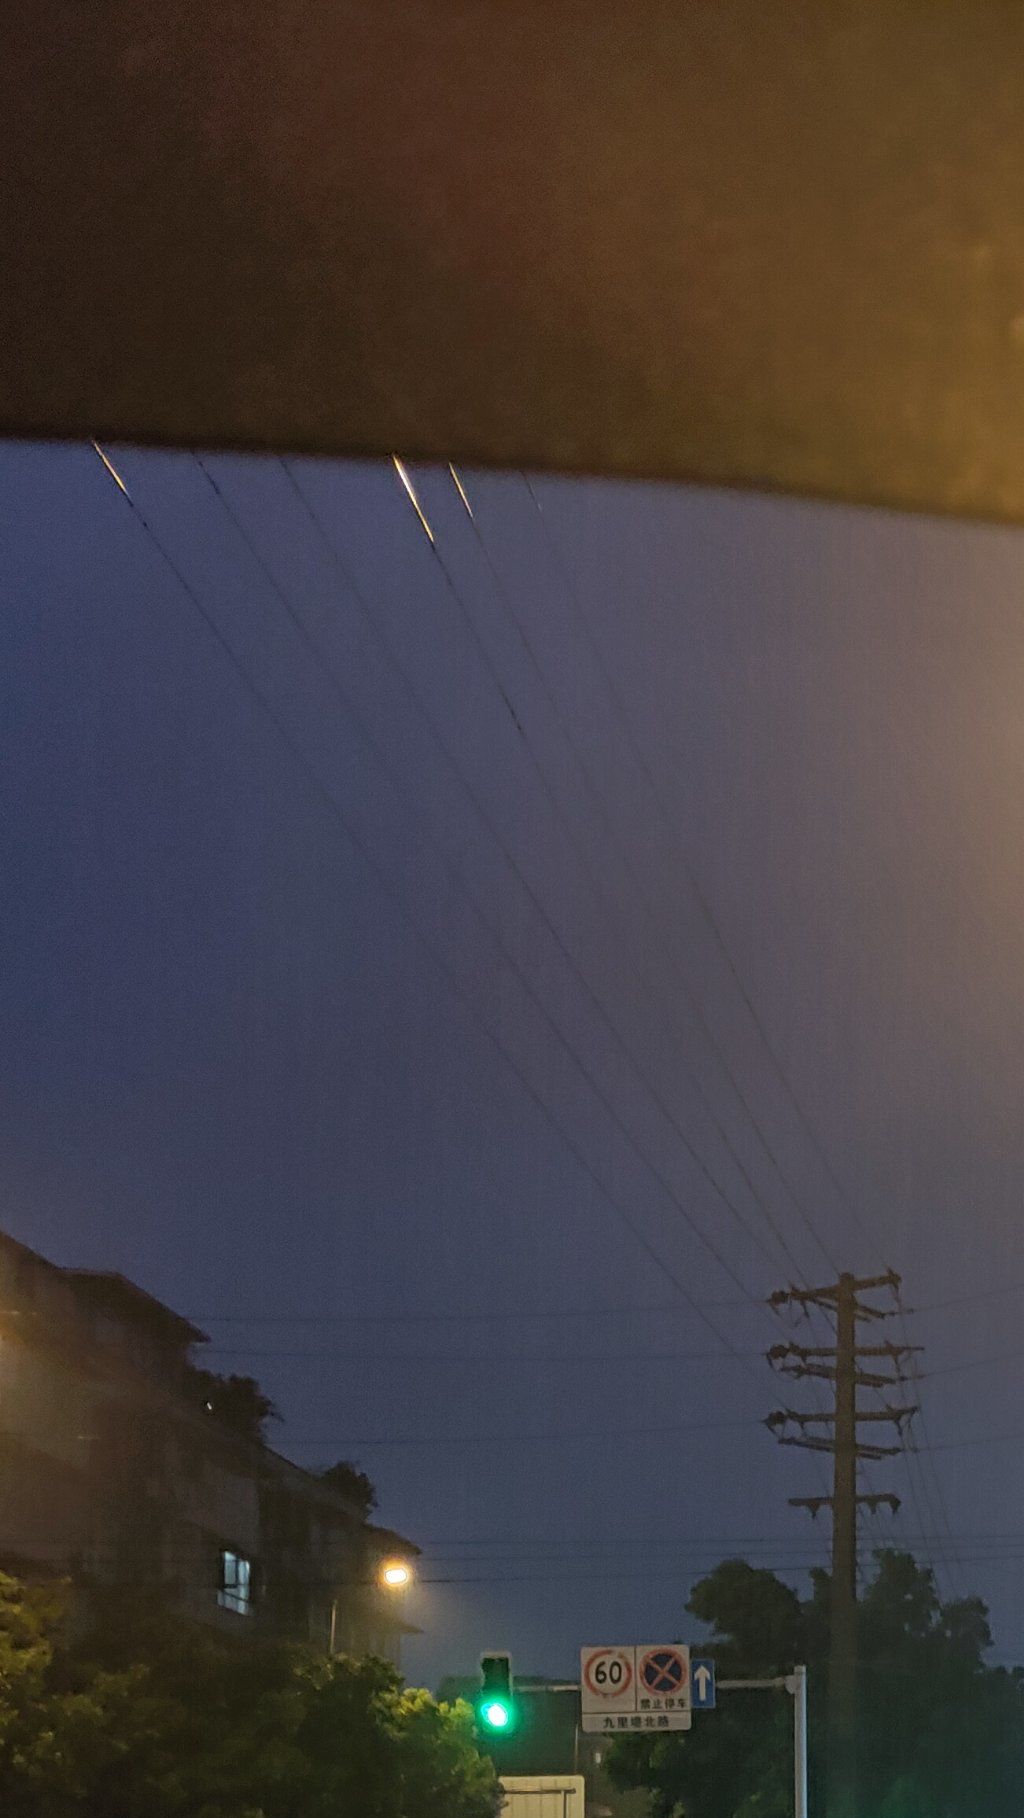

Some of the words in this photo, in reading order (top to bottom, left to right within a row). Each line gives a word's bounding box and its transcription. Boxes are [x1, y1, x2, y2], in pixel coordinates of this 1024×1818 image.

[595, 1660, 622, 1684] 60
[640, 1698, 686, 1710] 禁止停车
